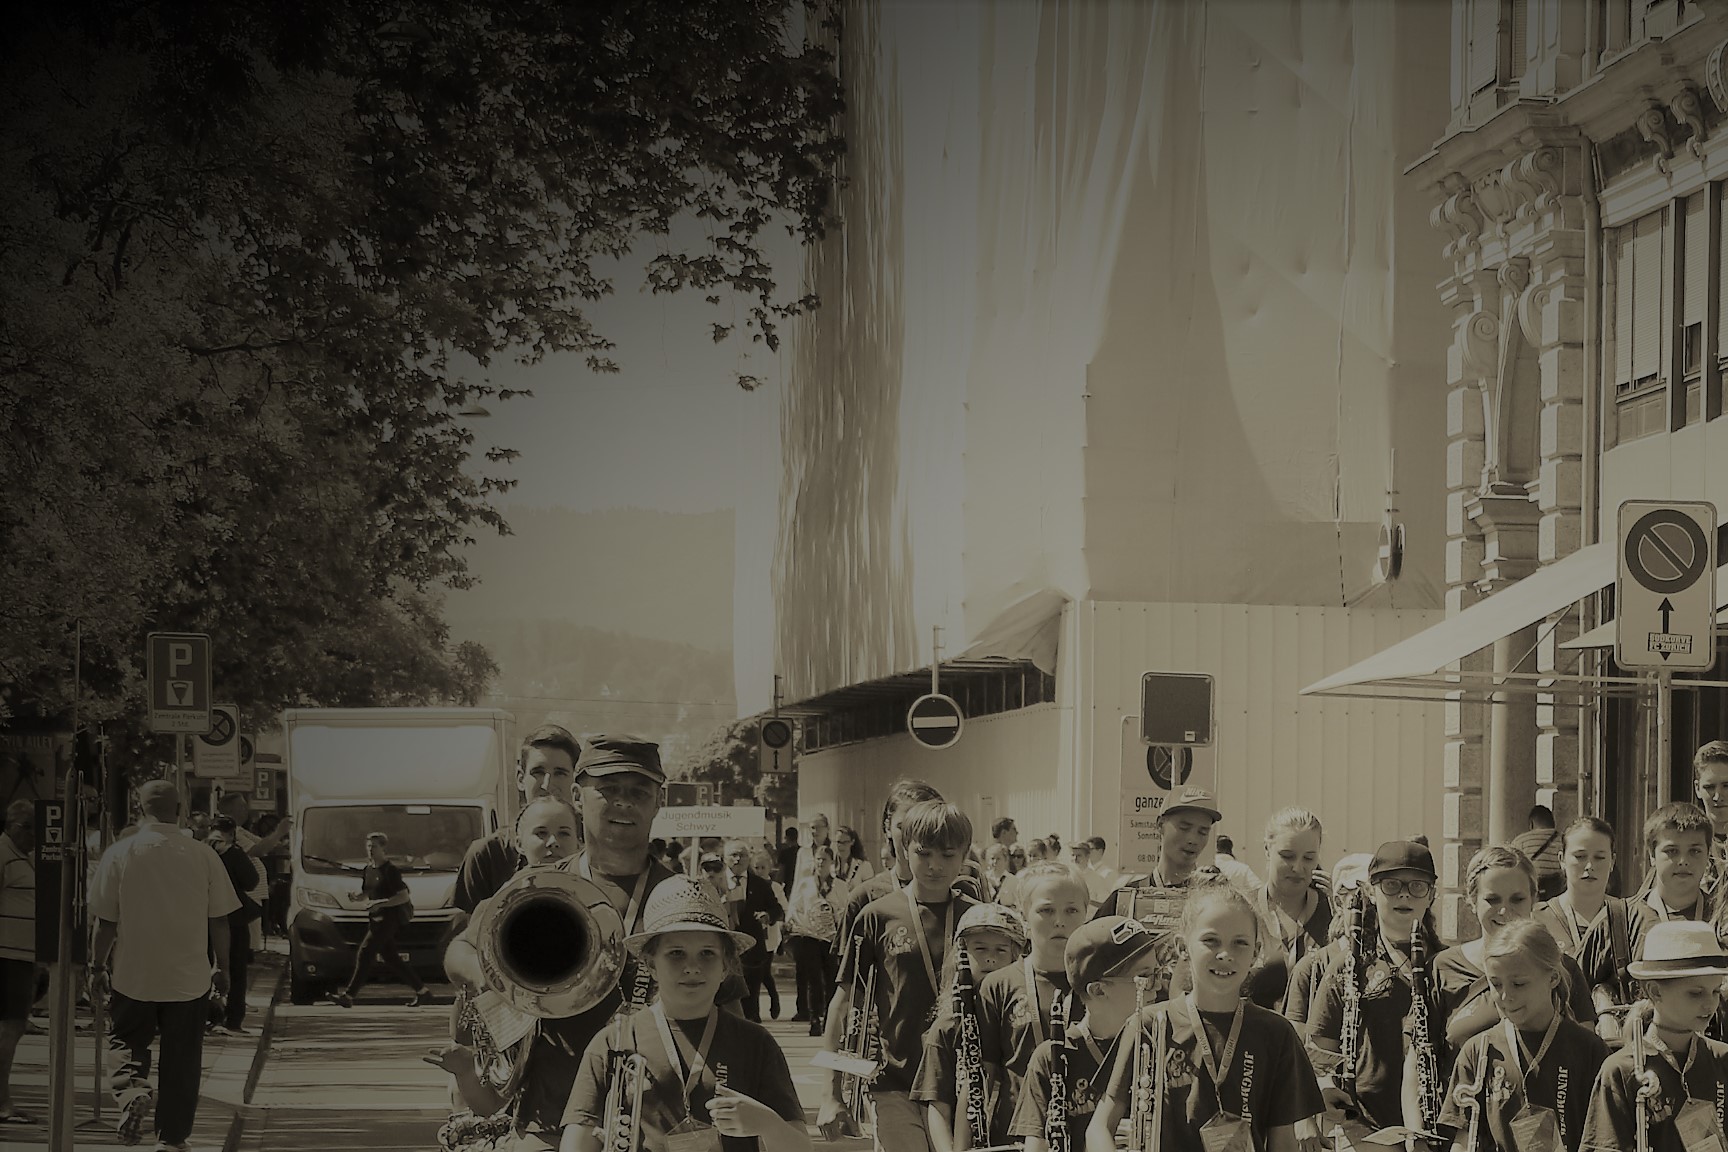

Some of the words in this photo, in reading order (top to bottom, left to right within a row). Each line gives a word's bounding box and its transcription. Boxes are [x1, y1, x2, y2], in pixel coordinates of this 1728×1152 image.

[169, 643, 192, 677] P
[258, 772, 269, 787] P
[1185, 788, 1206, 797] NIKE
[1135, 796, 1164, 812] ganze
[46, 806, 61, 826] P
[662, 811, 732, 822] Jugendmusik
[676, 823, 717, 832] Schwyz
